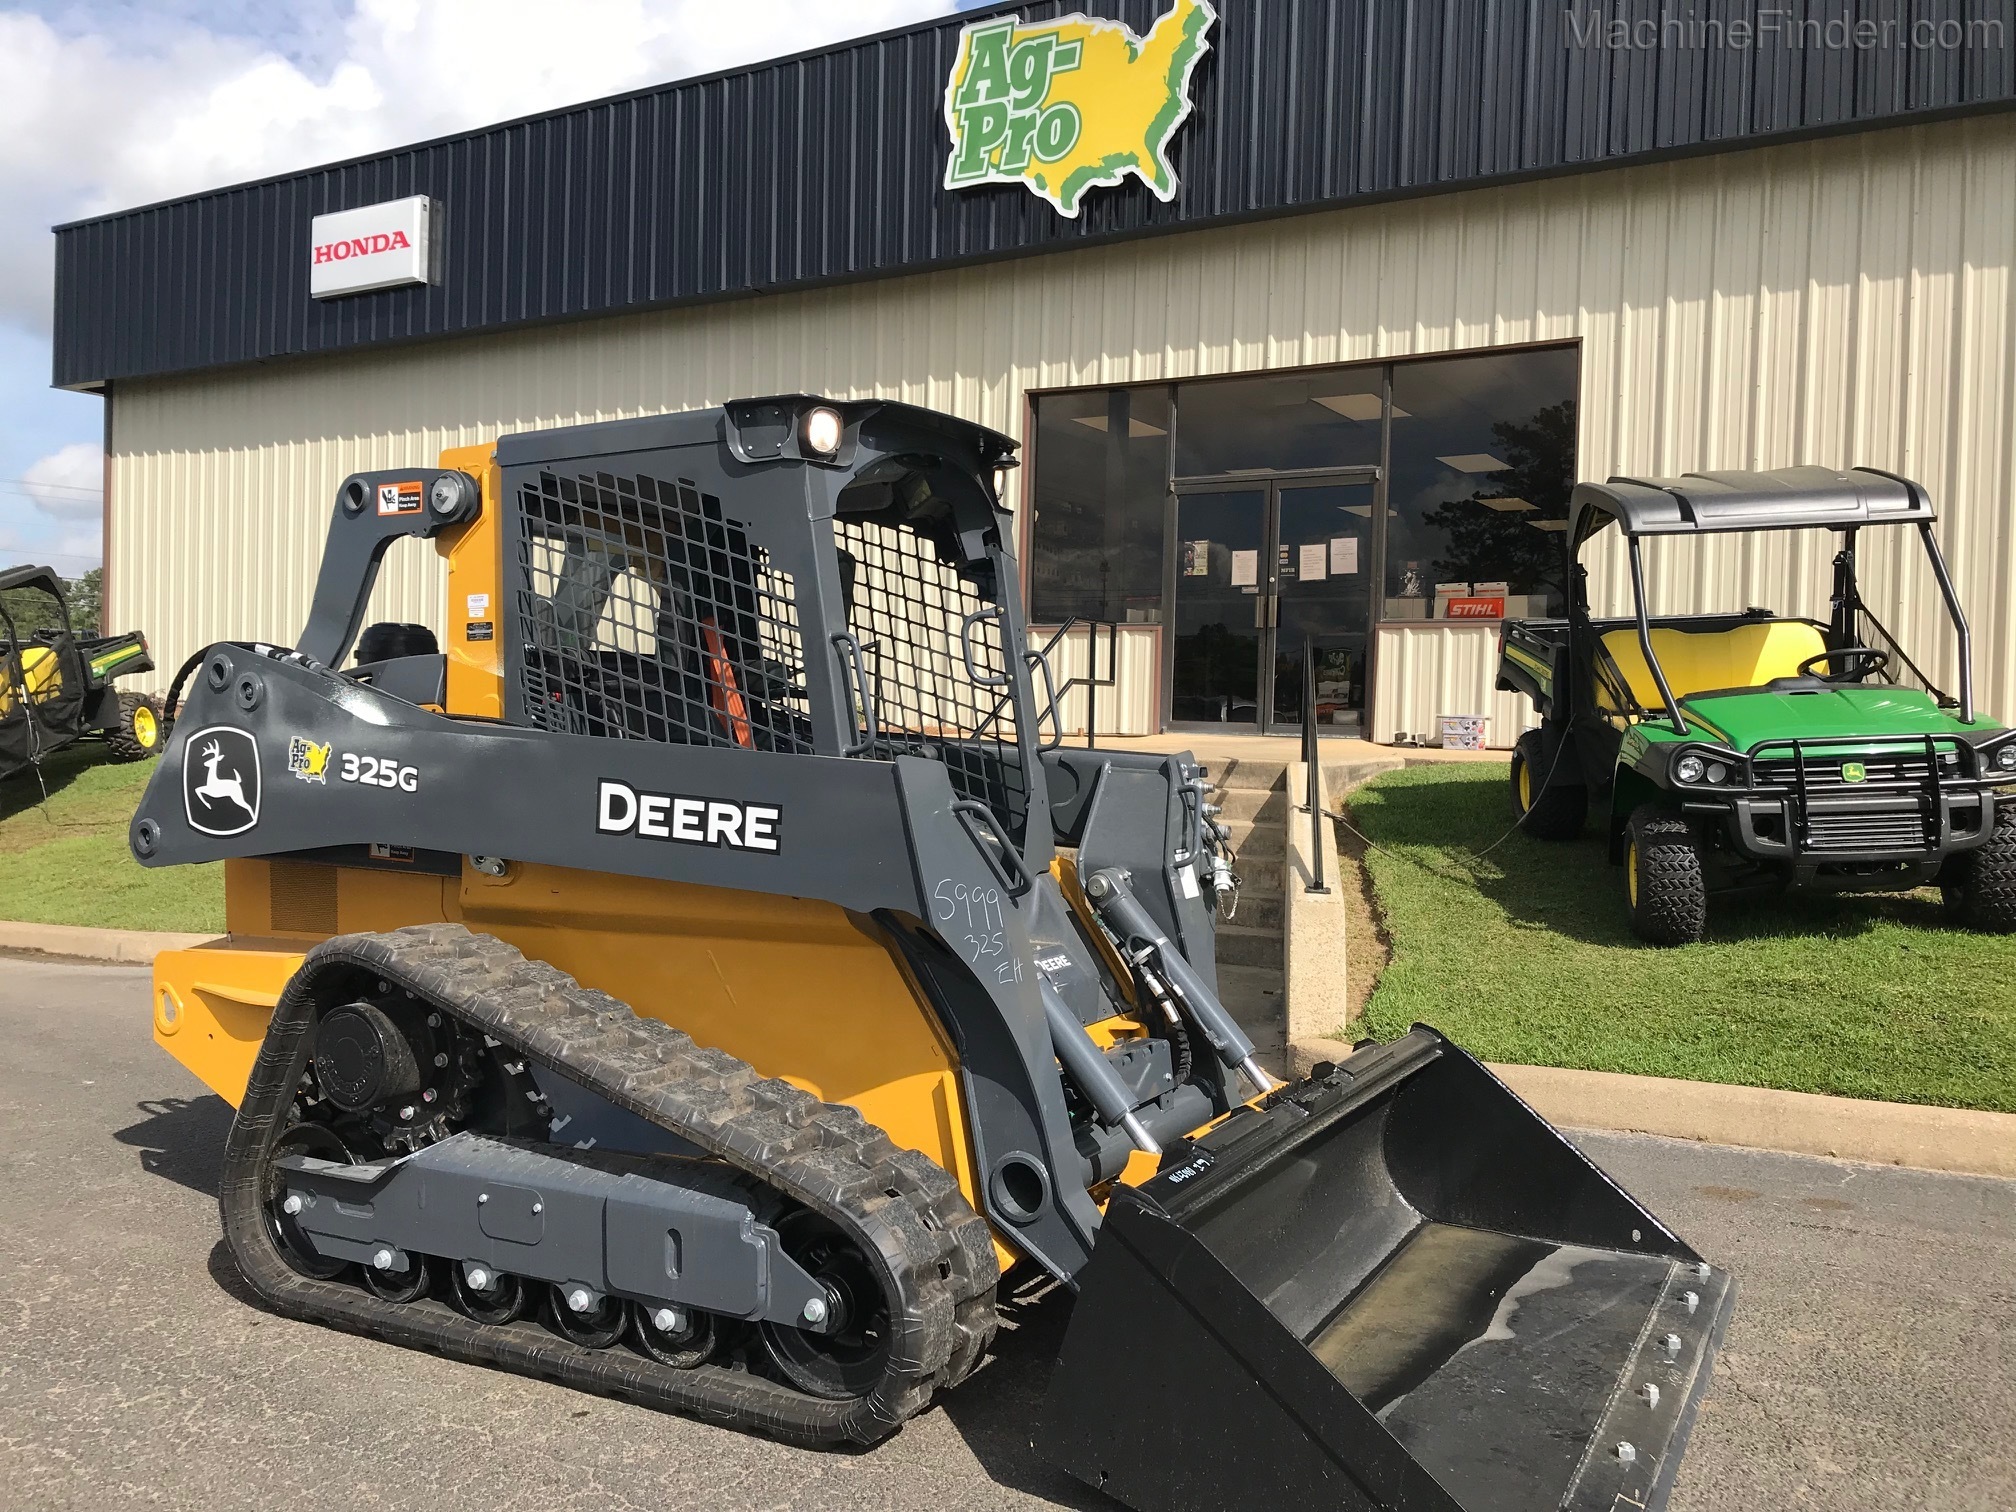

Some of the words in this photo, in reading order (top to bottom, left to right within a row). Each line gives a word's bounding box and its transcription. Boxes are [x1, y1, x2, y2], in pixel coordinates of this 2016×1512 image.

[957, 26, 1080, 112] Ag-
[954, 102, 1079, 178] Pro
[314, 230, 411, 265] HONDA
[1451, 604, 1496, 615] STIHL
[290, 753, 310, 769] Pro
[291, 739, 311, 757] Ag-
[340, 753, 418, 793] 325G
[599, 782, 779, 851] DEERE
[934, 878, 1004, 931] 5999
[963, 931, 1004, 963] 325
